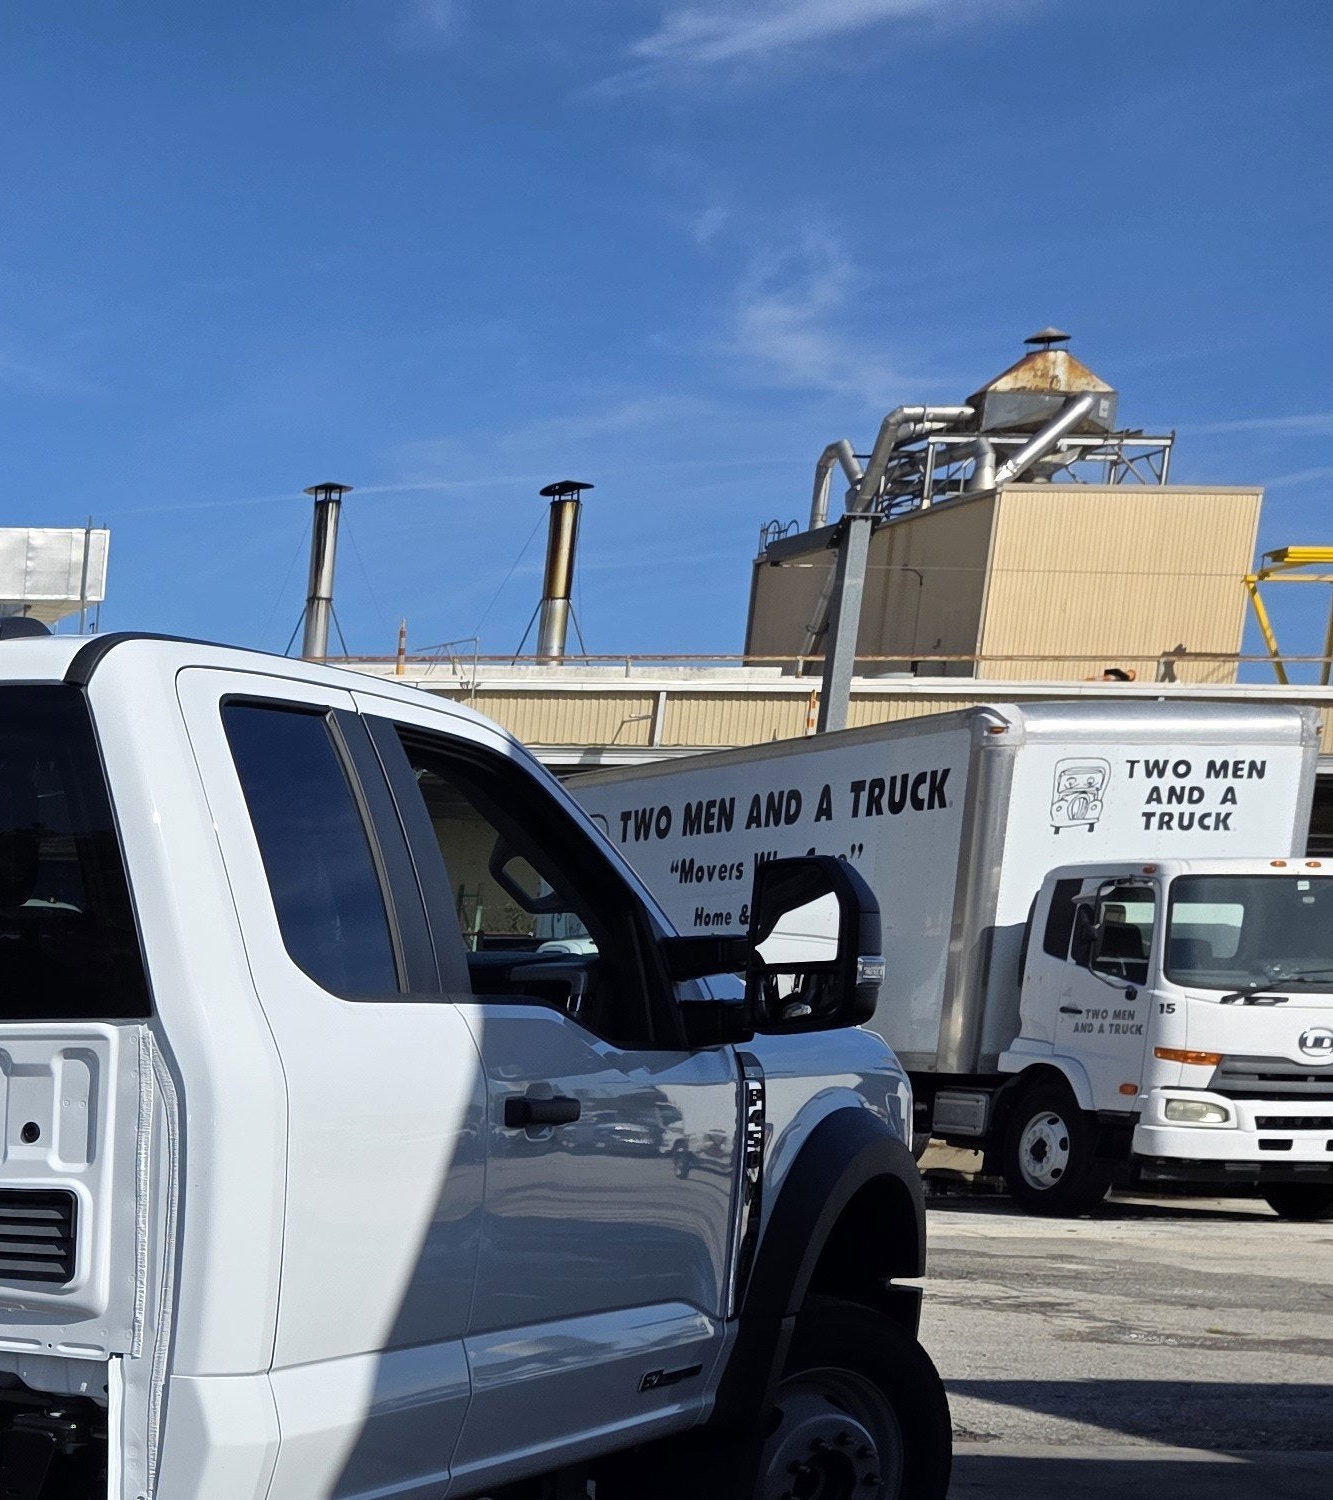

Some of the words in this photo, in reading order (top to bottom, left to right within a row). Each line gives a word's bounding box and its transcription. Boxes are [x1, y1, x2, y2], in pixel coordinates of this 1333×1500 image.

[1126, 759, 1192, 779] TWO
[1205, 760, 1267, 779] MEN
[1145, 786, 1205, 805] AND
[1220, 786, 1237, 805] A
[620, 806, 672, 843] TWO
[682, 797, 735, 836] MEN
[745, 789, 802, 830] AND
[814, 784, 833, 823] A
[850, 768, 951, 818] TRUCK
[1141, 812, 1233, 831] TRUCK
[694, 905, 732, 926] Home
[739, 904, 750, 925] &
[1085, 1009, 1108, 1020] TWO
[1112, 1009, 1135, 1020] MEN
[1159, 1003, 1176, 1014] 15
[1073, 1022, 1094, 1034] AND
[1097, 1023, 1105, 1034] A
[1108, 1024, 1143, 1036] TRUCK
